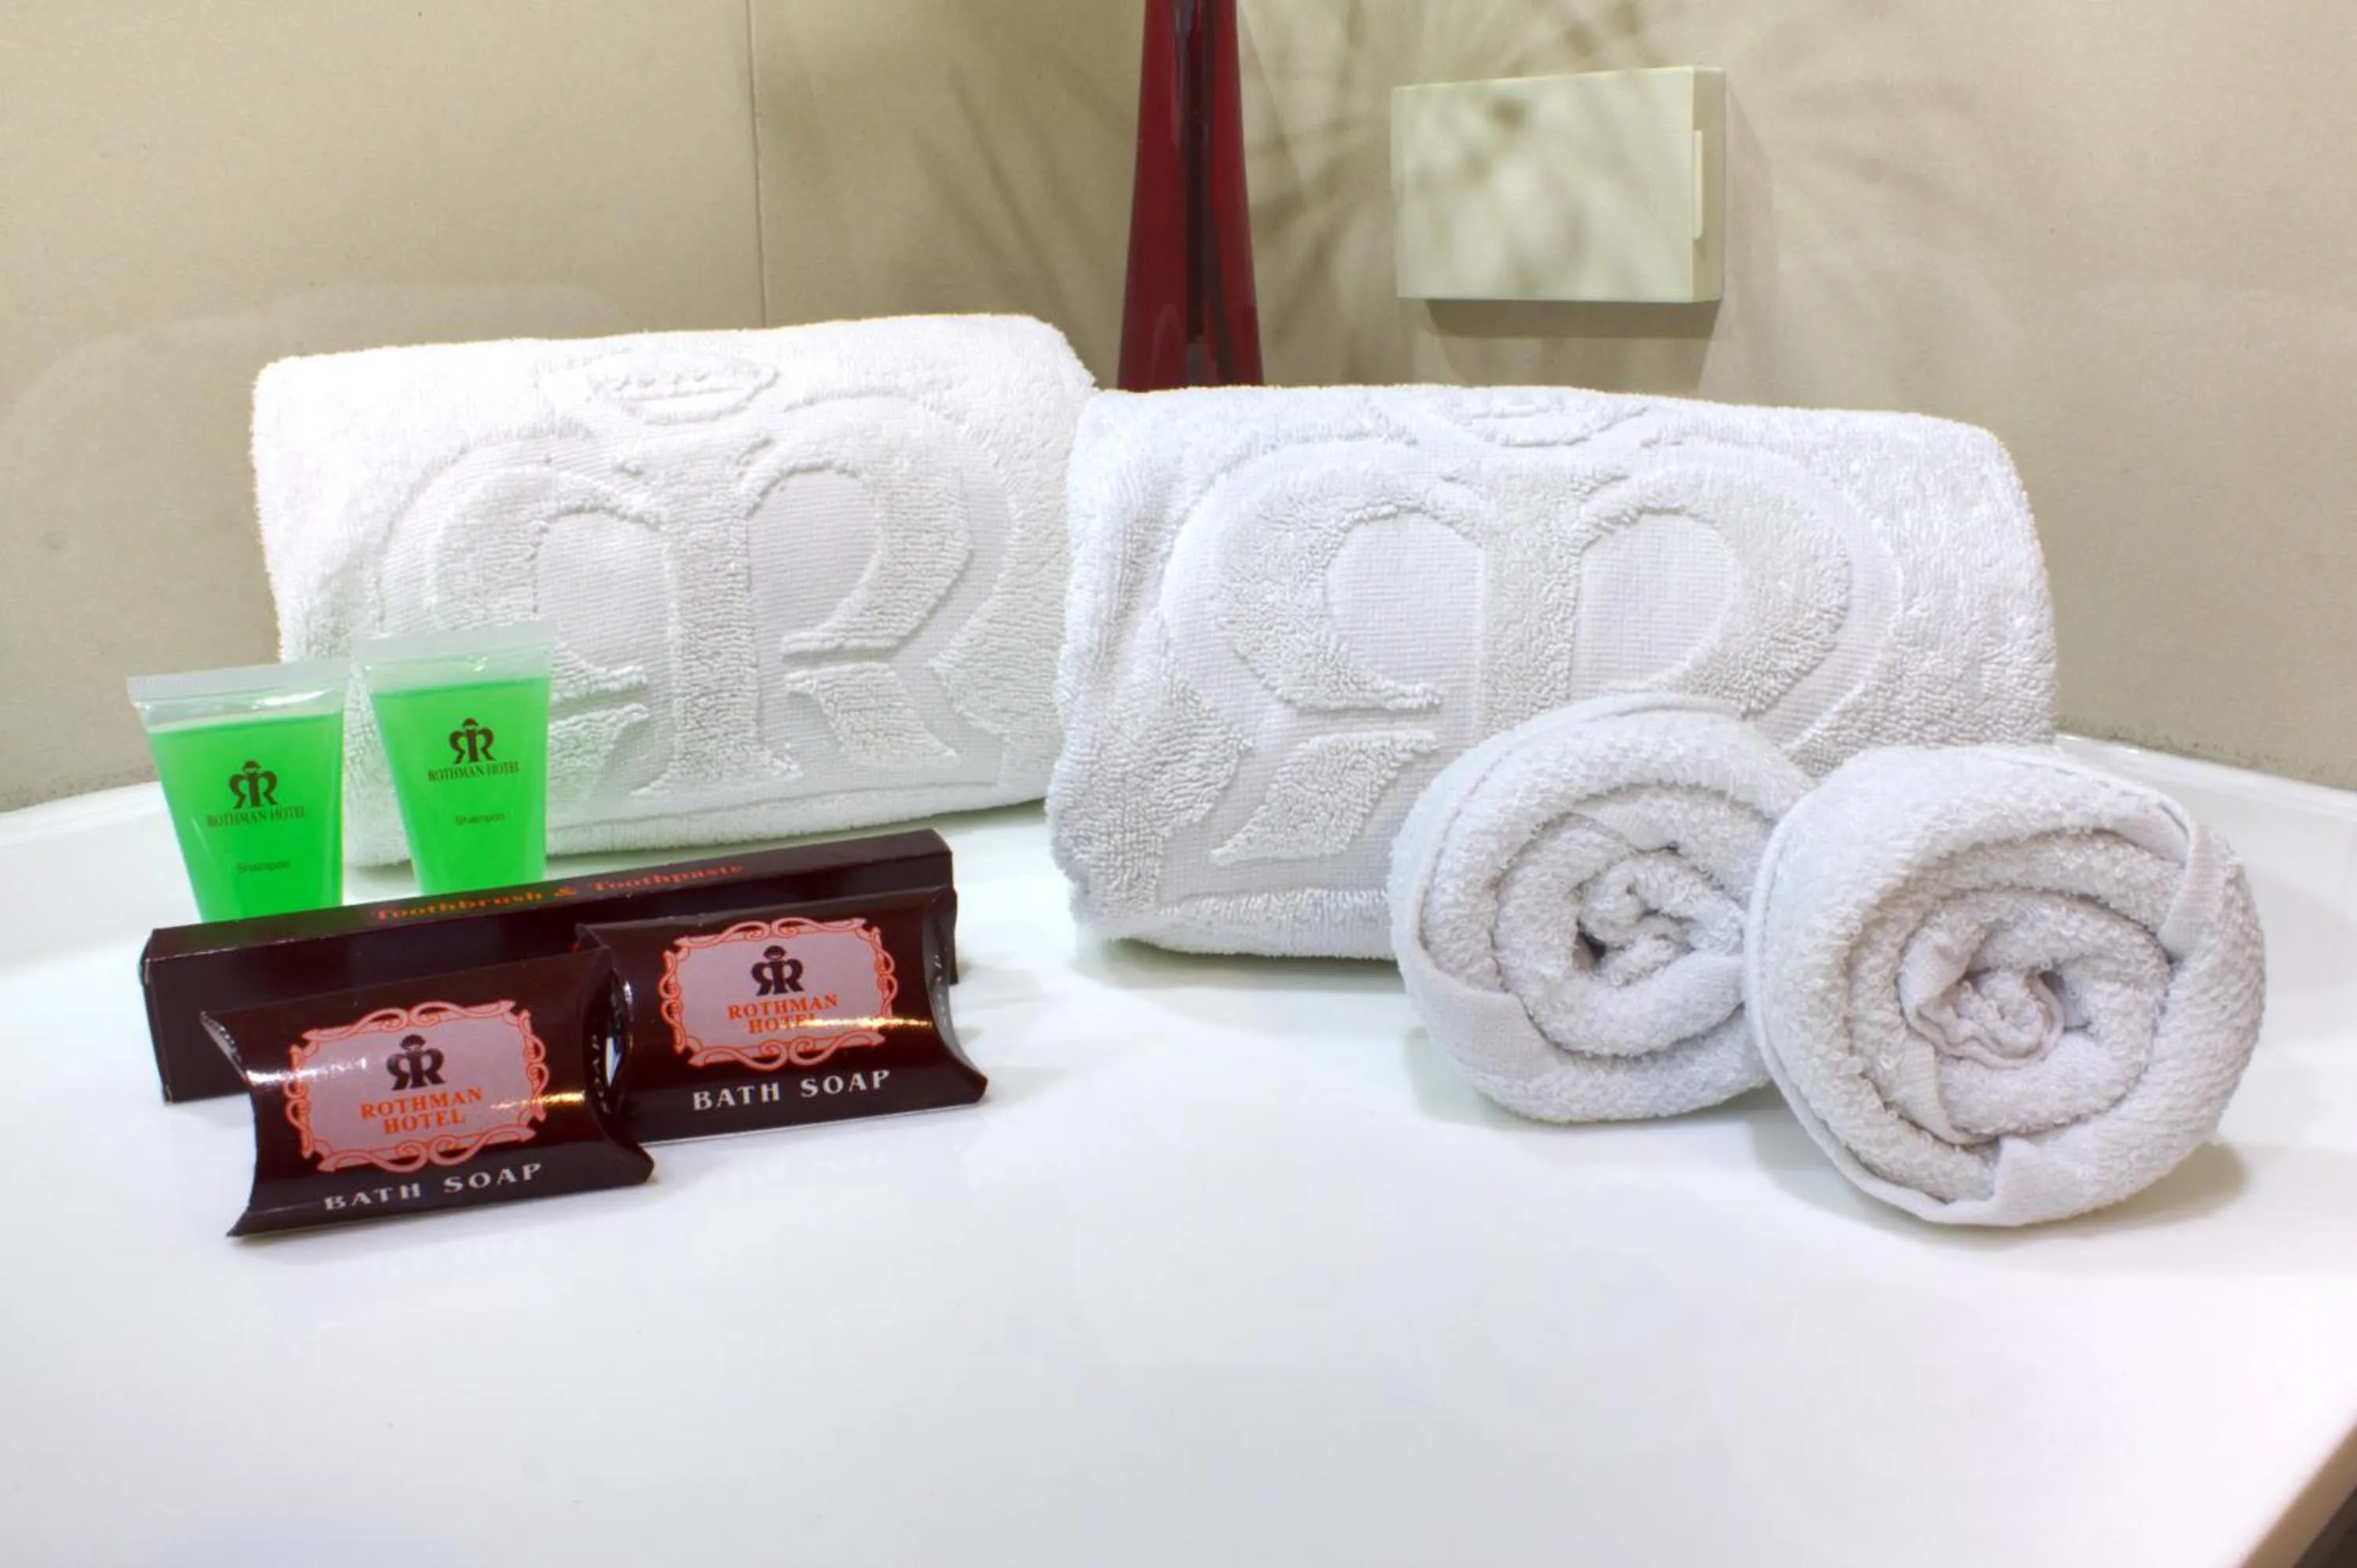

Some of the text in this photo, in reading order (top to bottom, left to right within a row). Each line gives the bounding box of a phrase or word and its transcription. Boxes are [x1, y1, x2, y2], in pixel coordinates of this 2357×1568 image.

[427, 760, 520, 782] ROTHMAN HOTEL
[206, 805, 306, 829] ROTHMAN HOTEL
[455, 812, 506, 826] Shampoo
[236, 860, 291, 874] Shampoo
[372, 865, 744, 922] Toothbrush & Toothpaste
[728, 993, 838, 1020] ROTHMAN
[360, 1086, 483, 1120] ROTHMAN
[692, 1069, 890, 1111] BATH SOAP
[383, 1109, 466, 1135] HOTEL
[324, 1163, 542, 1211] BATH SOAP
